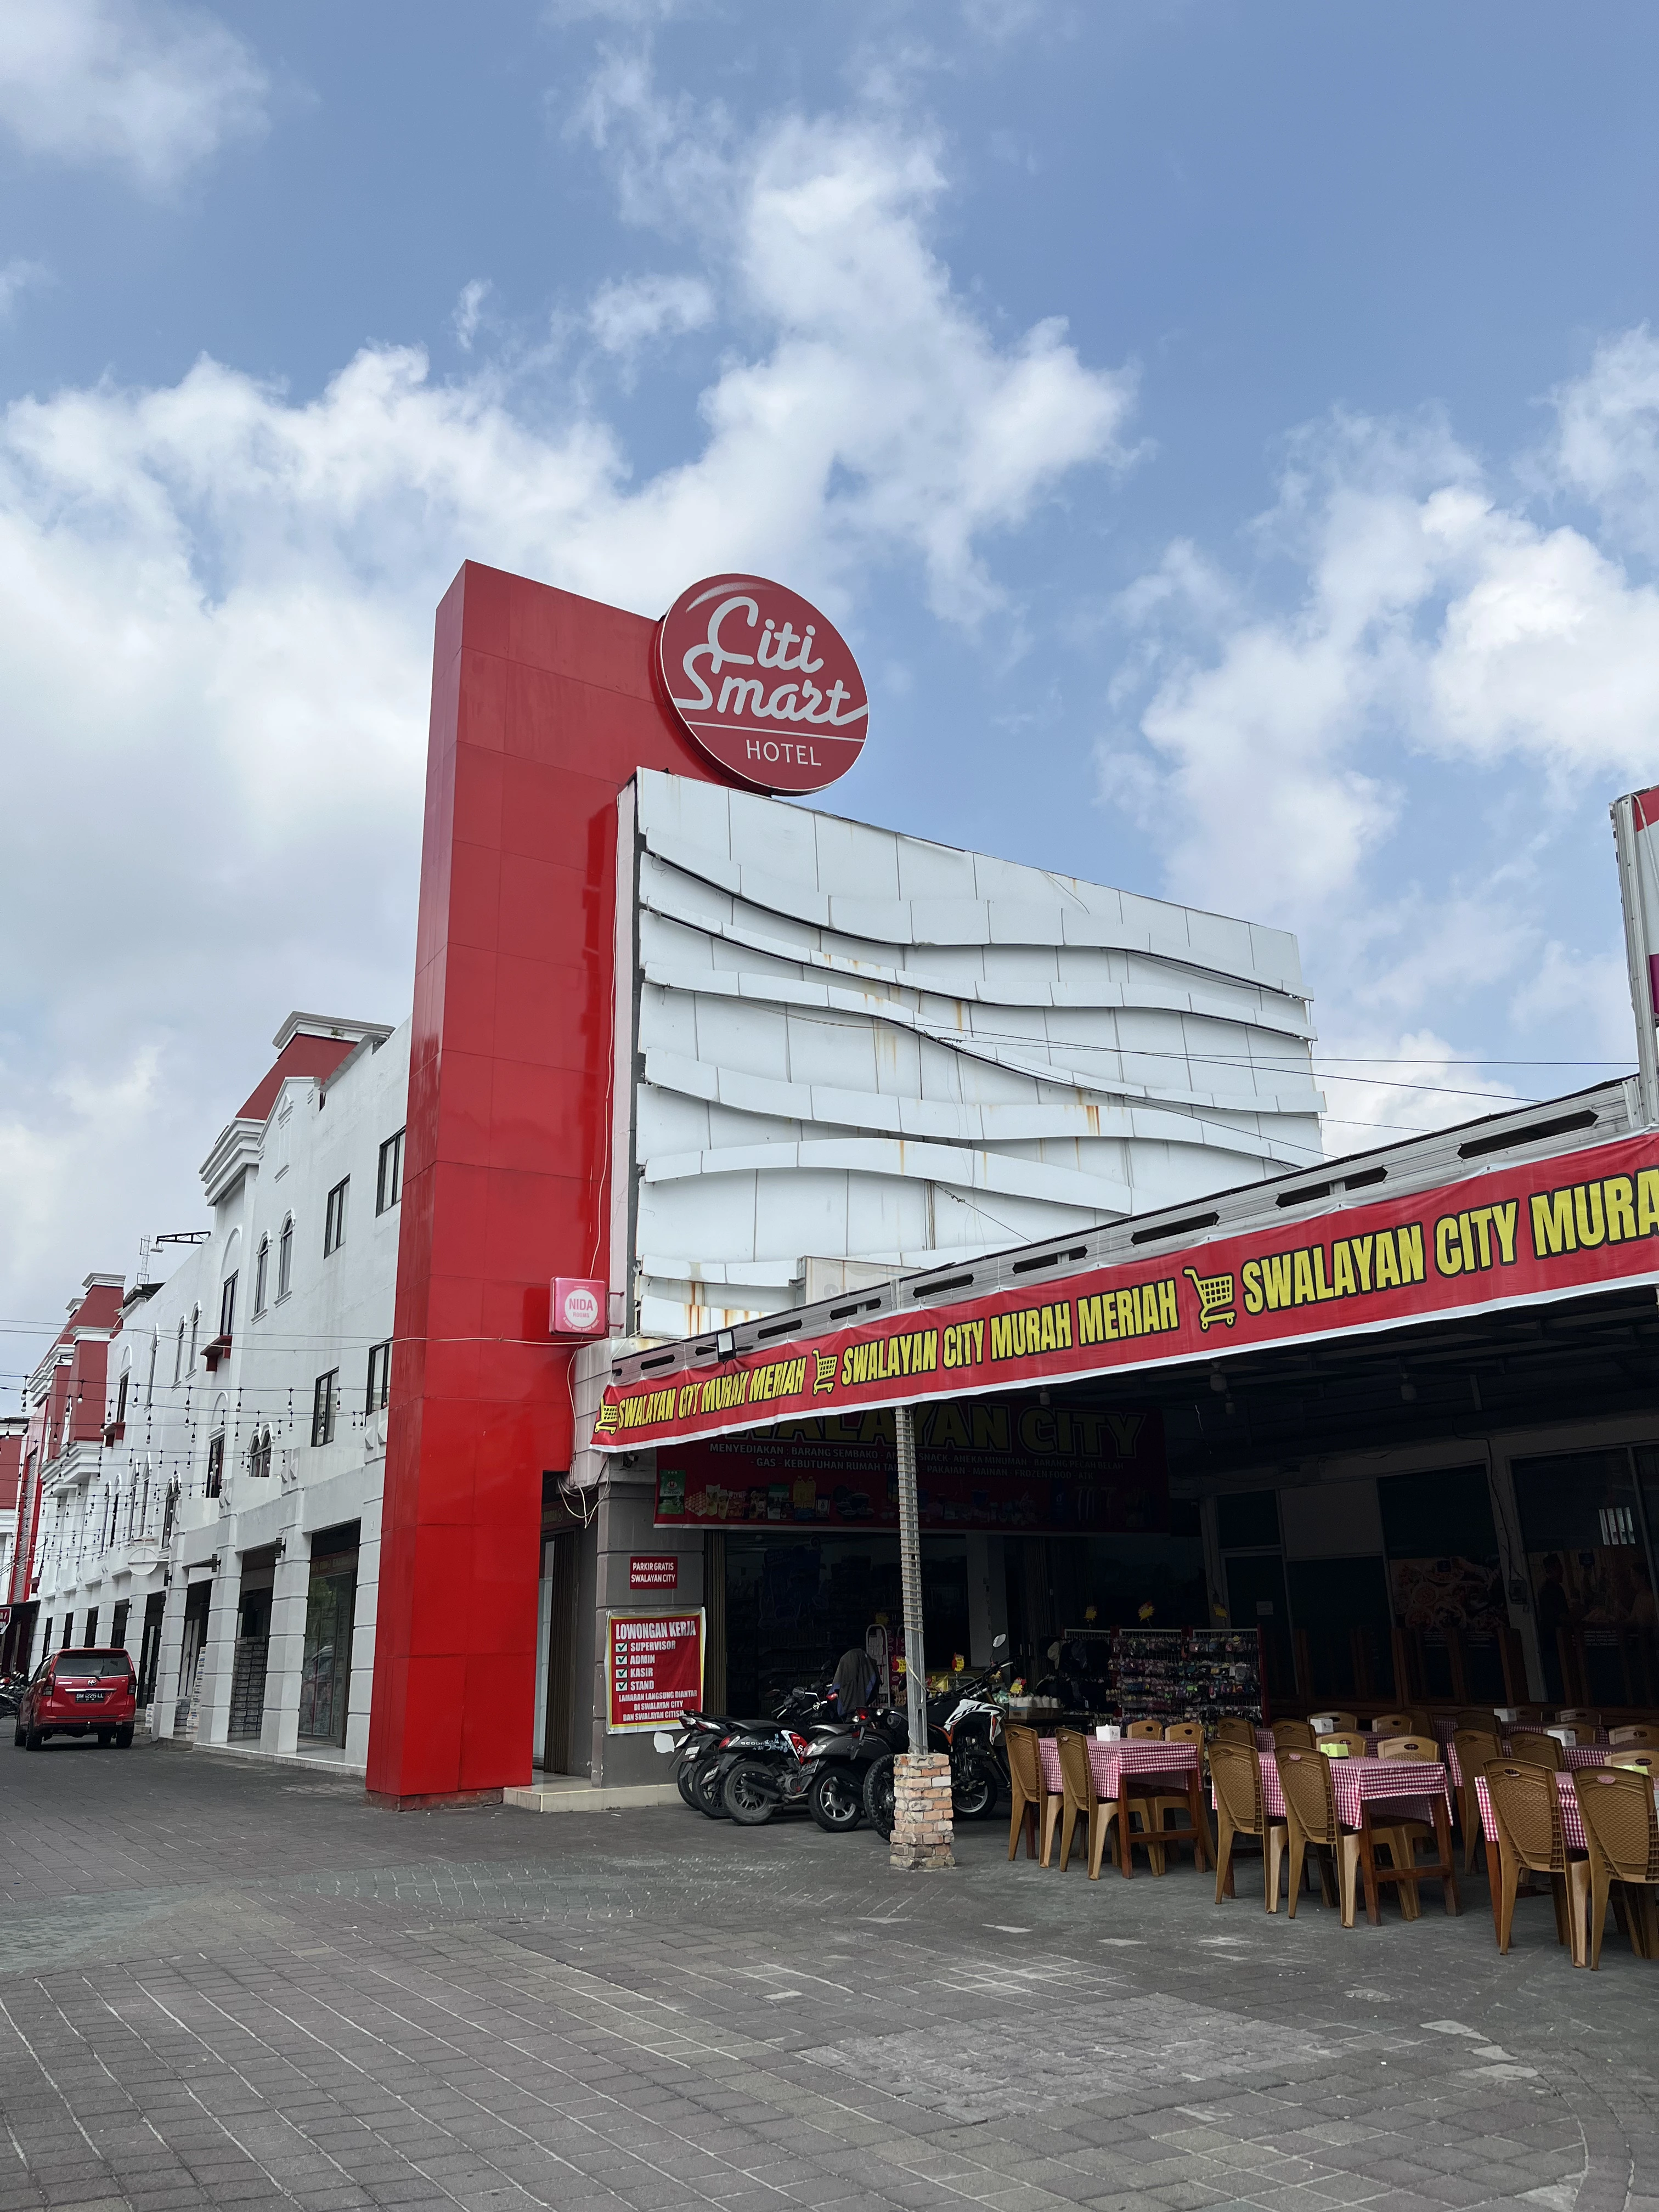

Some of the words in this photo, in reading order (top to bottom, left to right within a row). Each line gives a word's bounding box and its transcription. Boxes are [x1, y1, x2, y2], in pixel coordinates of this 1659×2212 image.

[708, 596, 823, 673] Citi
[673, 644, 868, 725] Smart
[746, 740, 821, 766] HOTEL
[1242, 1223, 1425, 1314] SWALAYAN
[1436, 1200, 1519, 1276] CITY
[1531, 1169, 1659, 1256] MURA
[569, 1298, 593, 1311] NIDA
[840, 1329, 938, 1386] SWALAYAN
[944, 1319, 985, 1369] CITY
[991, 1301, 1072, 1361] MURAH
[1078, 1279, 1178, 1345] MERIAH
[618, 1389, 676, 1428] SWALAYAN
[679, 1381, 702, 1419] CITY
[701, 1370, 750, 1413] MURAH
[749, 1357, 807, 1402] MERIAH
[1019, 1406, 1146, 1458] CITY
[710, 1443, 783, 1455] MENYEDIAKAN
[792, 1448, 831, 1458] BARANG
[833, 1449, 878, 1459] SEMBAKO
[953, 1454, 984, 1464] ANEKA
[985, 1456, 1027, 1466] MINUMAN
[1034, 1458, 1068, 1468] BARANG
[1069, 1460, 1096, 1469] PECAH
[1097, 1461, 1124, 1470] BELAH
[757, 1458, 776, 1467] GAS
[785, 1459, 845, 1470] KEBUTUHAN
[847, 1462, 881, 1471] RUMAH
[927, 1466, 966, 1476] PAKAIAN
[973, 1468, 1008, 1477] MAINAN
[1015, 1469, 1047, 1479] FROZEN
[1049, 1471, 1071, 1480] FOOD
[1079, 1471, 1093, 1480] ATK
[633, 1562, 653, 1571] PARKIR
[653, 1562, 674, 1571] GRATIS
[631, 1573, 662, 1583] SWALAYAN
[662, 1573, 676, 1583] CITY
[616, 1622, 668, 1640] LOWONGAN
[669, 1620, 696, 1637] KERJA
[630, 1640, 676, 1652] SUPERVISOR
[630, 1654, 655, 1664] ADMIN
[630, 1667, 653, 1678] KASIR
[630, 1680, 654, 1691] STAND
[618, 1694, 645, 1702] LAMARAN
[645, 1691, 674, 1701] LANGSUNG
[675, 1690, 697, 1698] DIANTAR
[641, 1701, 670, 1711] SWALAYAN
[670, 1700, 684, 1708] CITY
[635, 1711, 664, 1720] SWALAYAN
